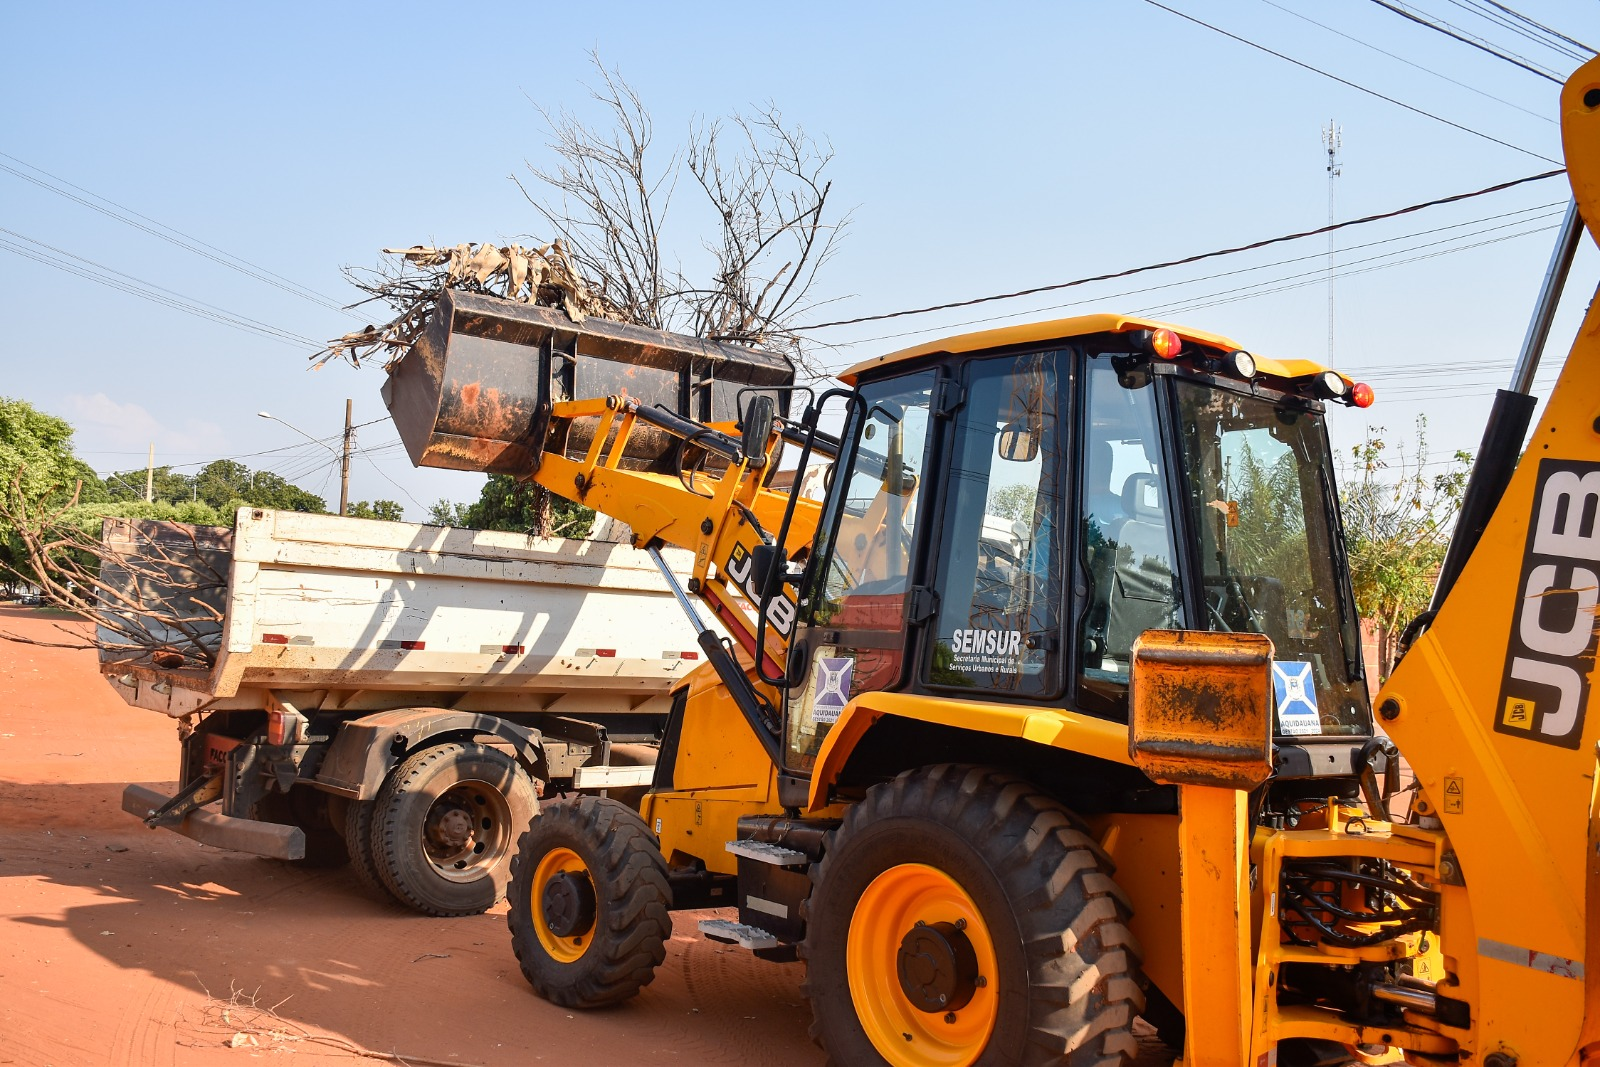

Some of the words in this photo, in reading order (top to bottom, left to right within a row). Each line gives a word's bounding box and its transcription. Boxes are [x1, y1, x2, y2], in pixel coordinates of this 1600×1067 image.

[1511, 470, 1600, 737] JCB
[951, 628, 1021, 655] SEMSUR
[953, 654, 980, 663] Secretaria
[981, 655, 1006, 666] Municipal
[1007, 656, 1015, 665] de
[949, 663, 971, 673] Serviços
[972, 664, 994, 673] Urbanos
[1000, 665, 1017, 674] Rurais
[813, 709, 841, 717] AQUIDAUA
[1511, 703, 1526, 722] JCB
[1280, 720, 1320, 728] AQUIDAUANA
